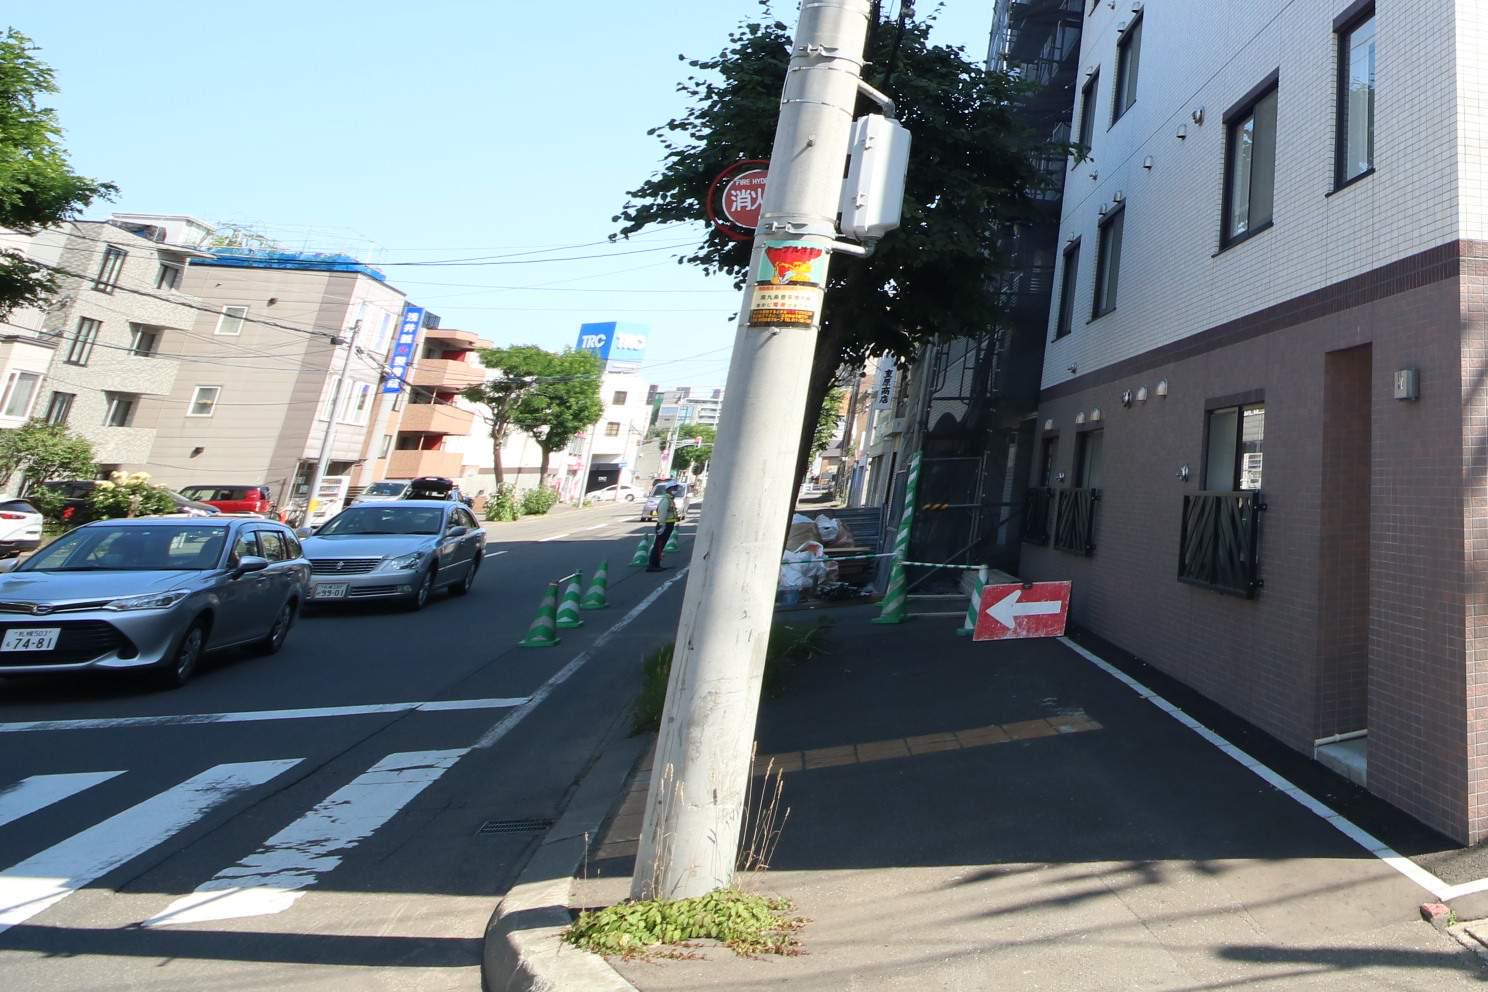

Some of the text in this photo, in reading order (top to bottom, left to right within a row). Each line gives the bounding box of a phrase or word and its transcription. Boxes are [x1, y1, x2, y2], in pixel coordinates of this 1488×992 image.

[736, 177, 768, 186] FIRE HYD
[731, 188, 764, 212] 消火
[582, 333, 607, 349] TRC
[13, 637, 53, 649] 74-81
